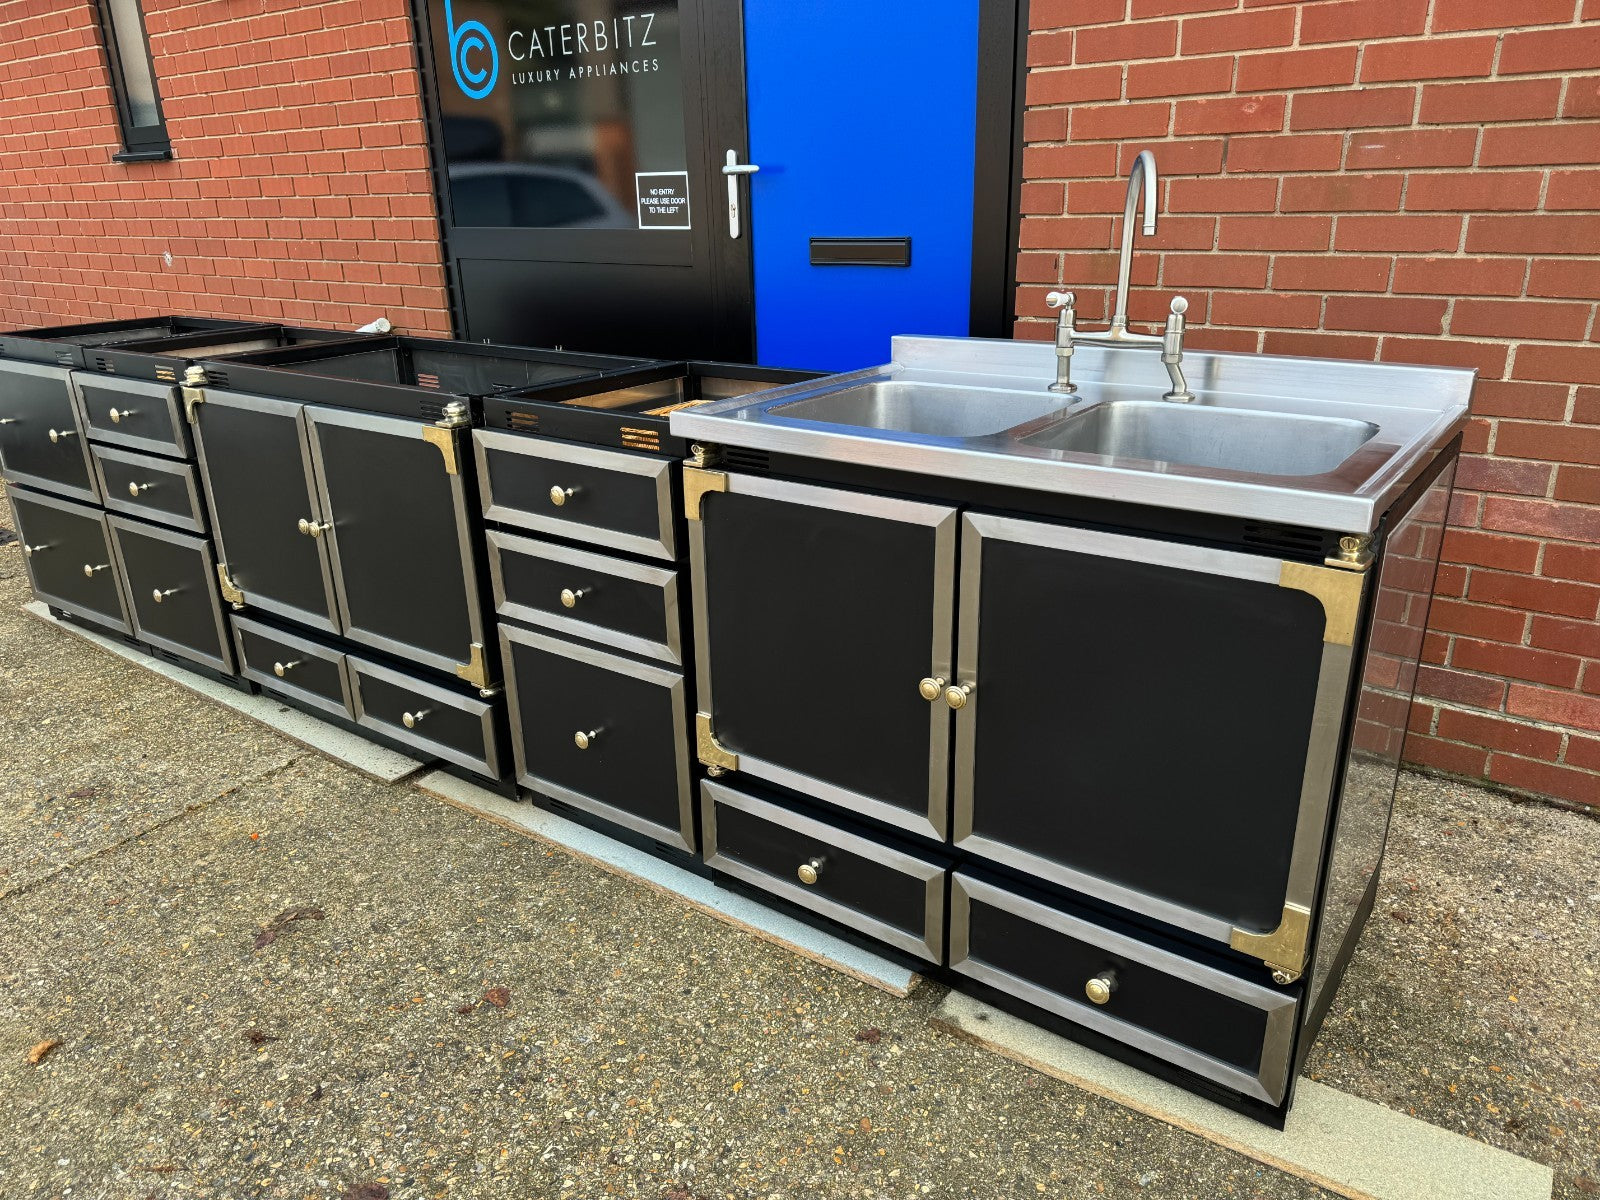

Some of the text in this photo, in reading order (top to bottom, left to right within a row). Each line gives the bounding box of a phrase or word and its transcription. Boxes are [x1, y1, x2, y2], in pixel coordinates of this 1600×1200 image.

[508, 13, 657, 61] CATERBITZ
[512, 58, 659, 85] LUXURY APPLIANCES
